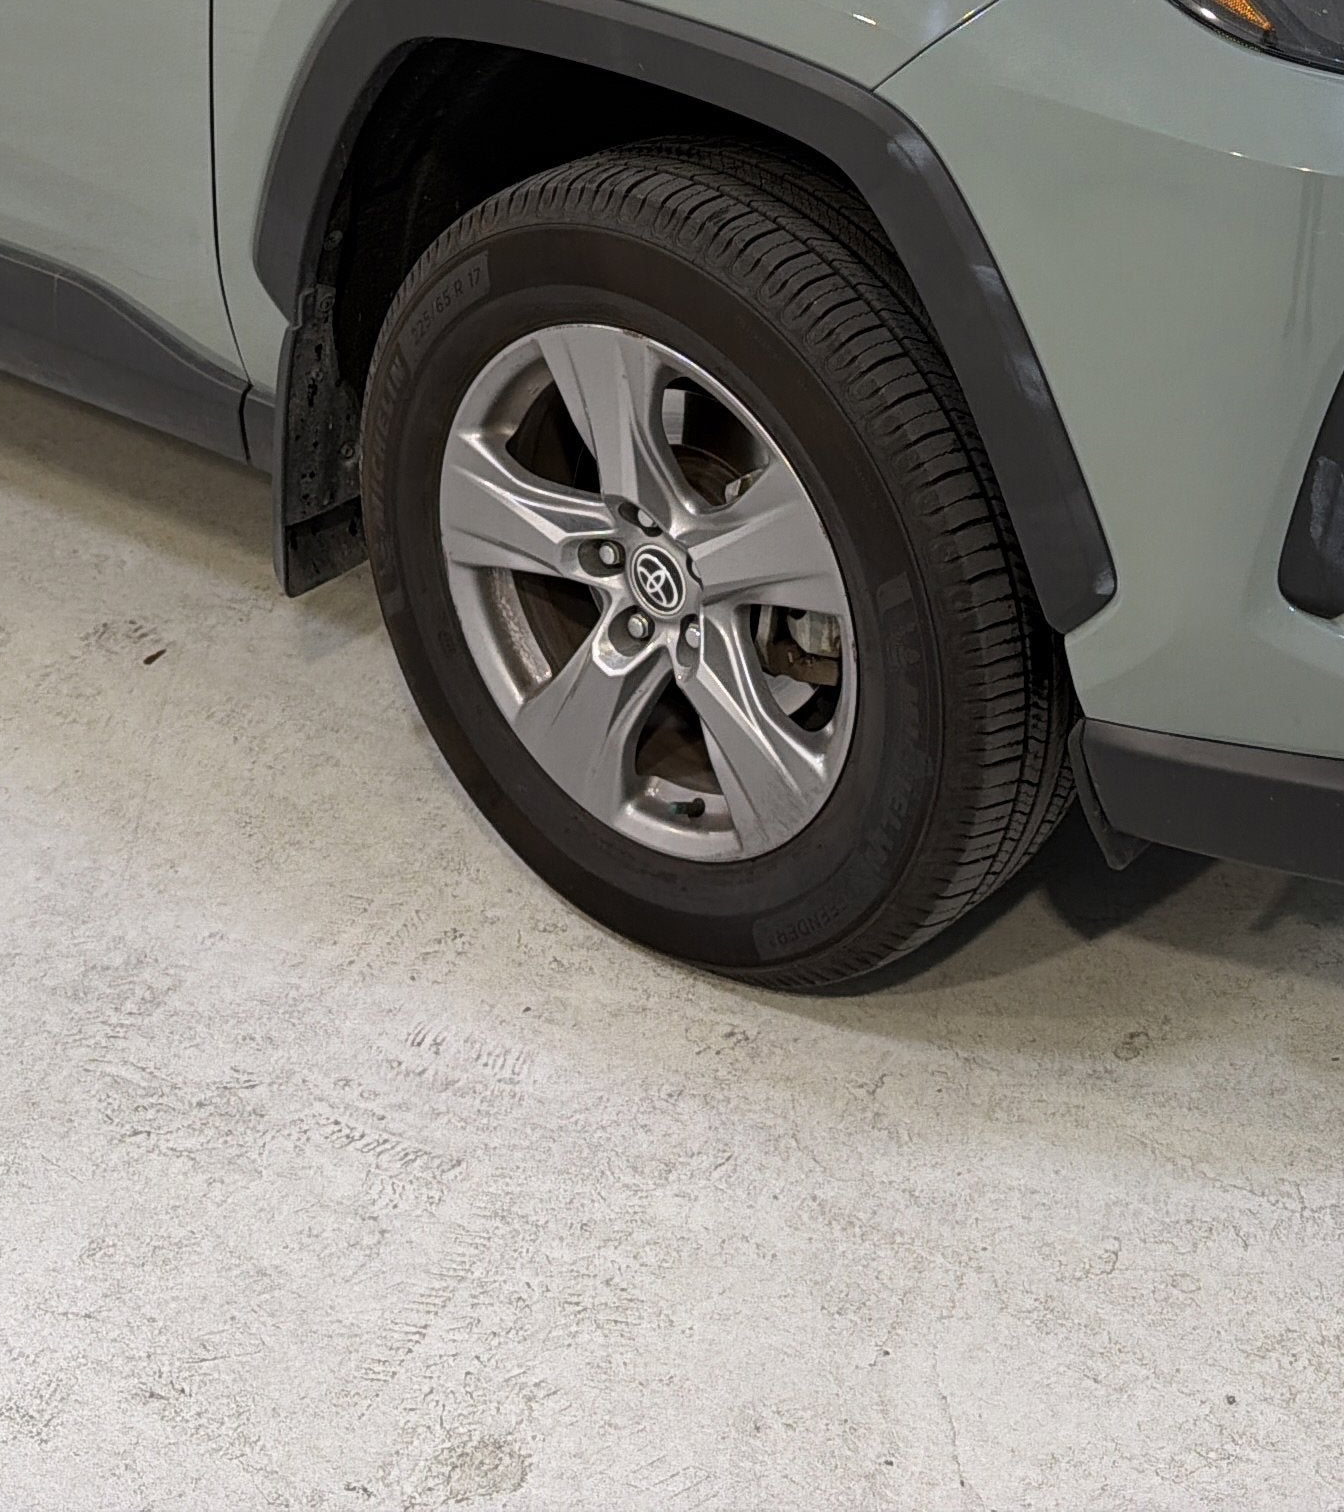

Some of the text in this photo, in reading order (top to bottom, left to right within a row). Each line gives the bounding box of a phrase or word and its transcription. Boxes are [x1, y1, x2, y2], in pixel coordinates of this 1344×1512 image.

[411, 268, 481, 346] 225/65 R 17
